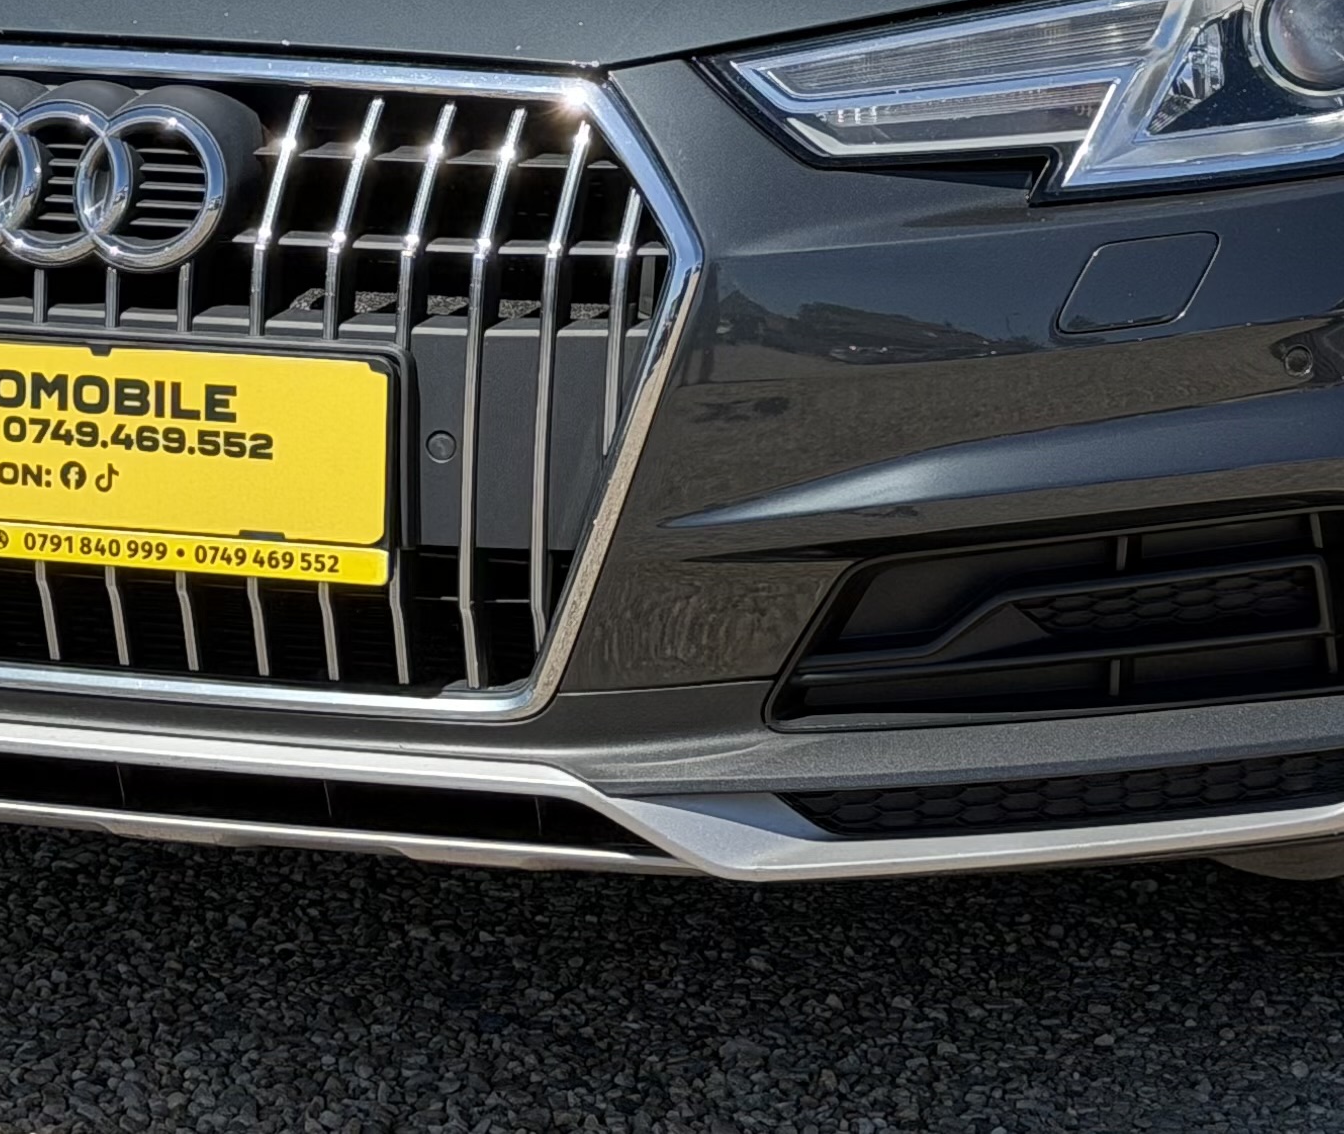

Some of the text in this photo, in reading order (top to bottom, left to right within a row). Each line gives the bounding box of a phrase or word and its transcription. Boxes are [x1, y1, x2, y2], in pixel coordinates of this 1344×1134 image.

[2, 415, 274, 460] 0749.469.552
[23, 531, 73, 554] 0791
[79, 535, 121, 558] 840
[126, 539, 168, 561] 999
[194, 544, 248, 566] 0749
[251, 548, 295, 570] 469
[300, 552, 340, 574] 552
